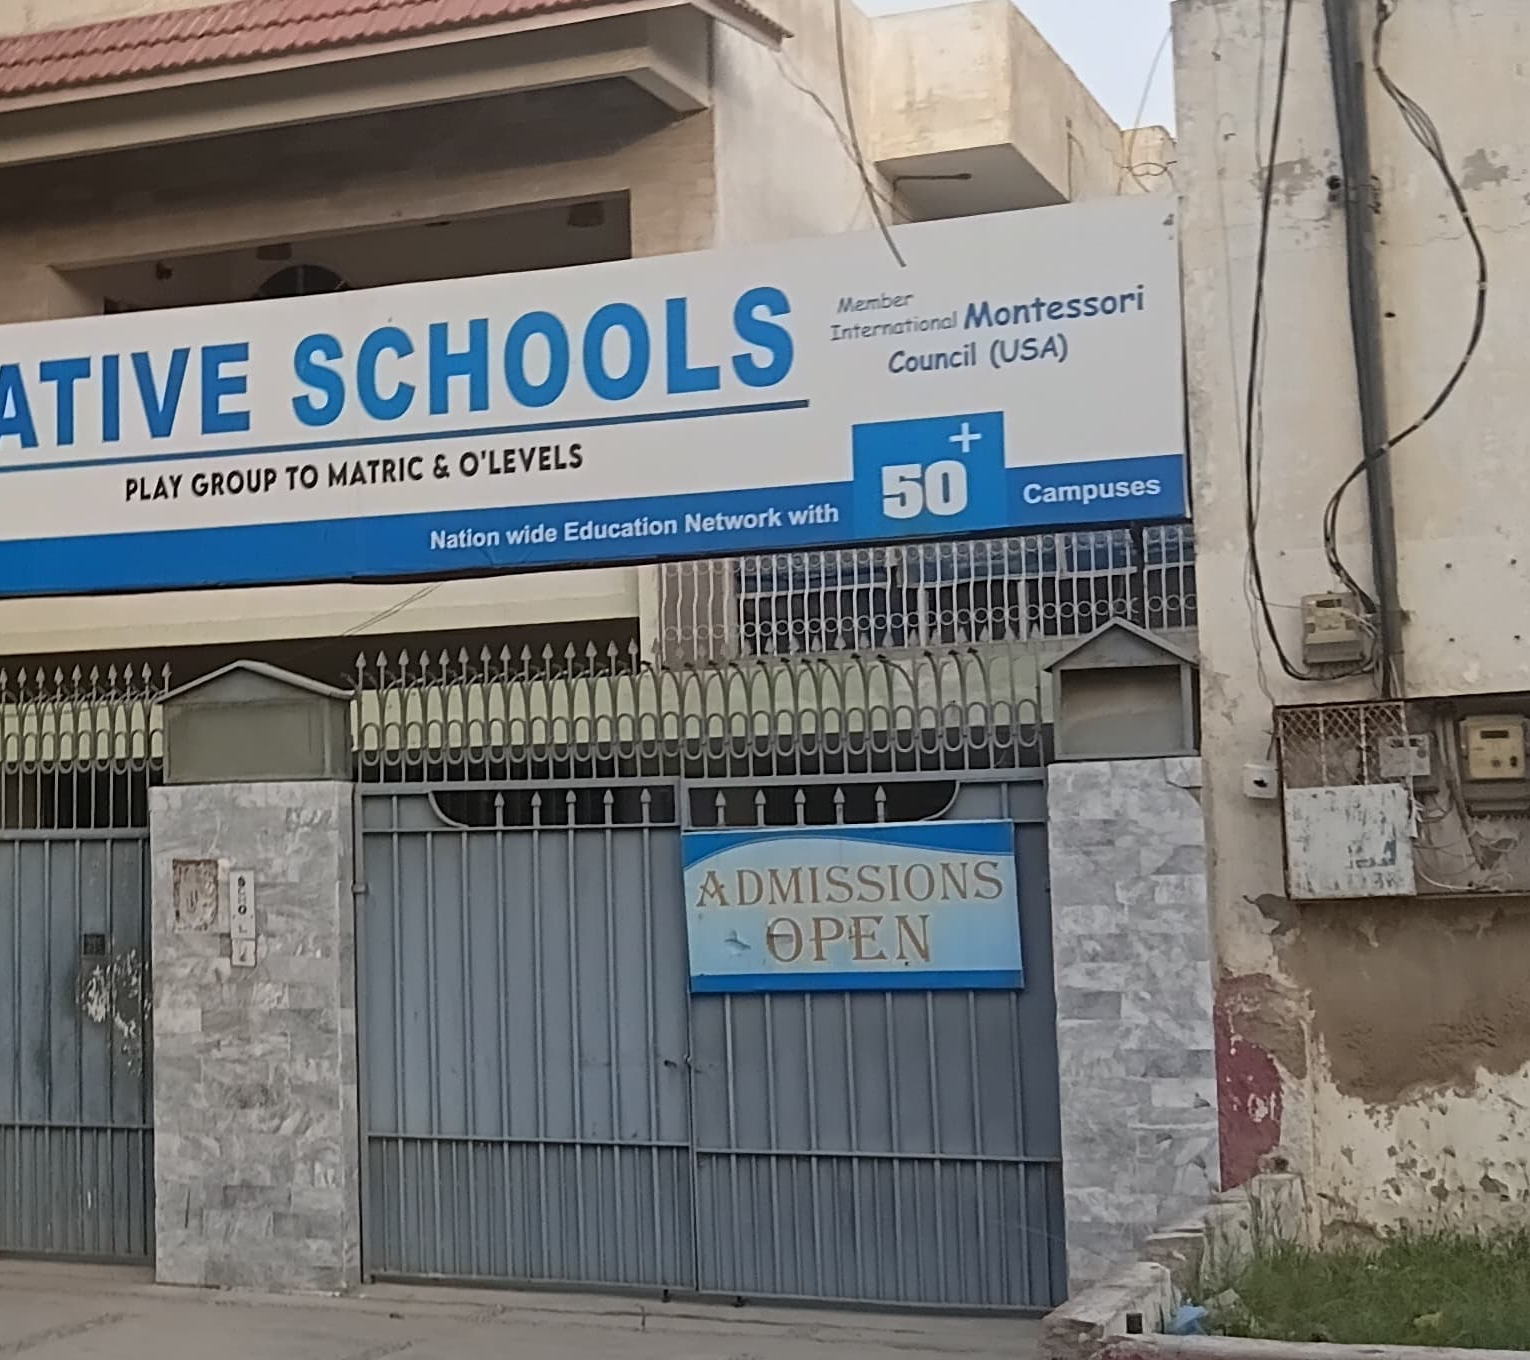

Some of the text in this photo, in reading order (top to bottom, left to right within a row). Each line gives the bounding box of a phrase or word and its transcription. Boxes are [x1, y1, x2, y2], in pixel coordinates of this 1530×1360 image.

[830, 284, 1145, 341] International Montessori
[836, 292, 914, 314] Member
[292, 286, 795, 427] SCHOOLS
[888, 333, 1069, 373] Council (USA)
[125, 443, 584, 502] PLAY GROUP TO MATRIC & O'LEVELS
[430, 529, 500, 550] Nation
[506, 523, 558, 544] wide
[564, 516, 678, 542] Education
[684, 508, 782, 534] Network
[788, 503, 840, 526] with
[1023, 478, 1162, 505] Campuses
[696, 860, 1004, 907] ADMISSIONS
[765, 914, 933, 963] OPEN
